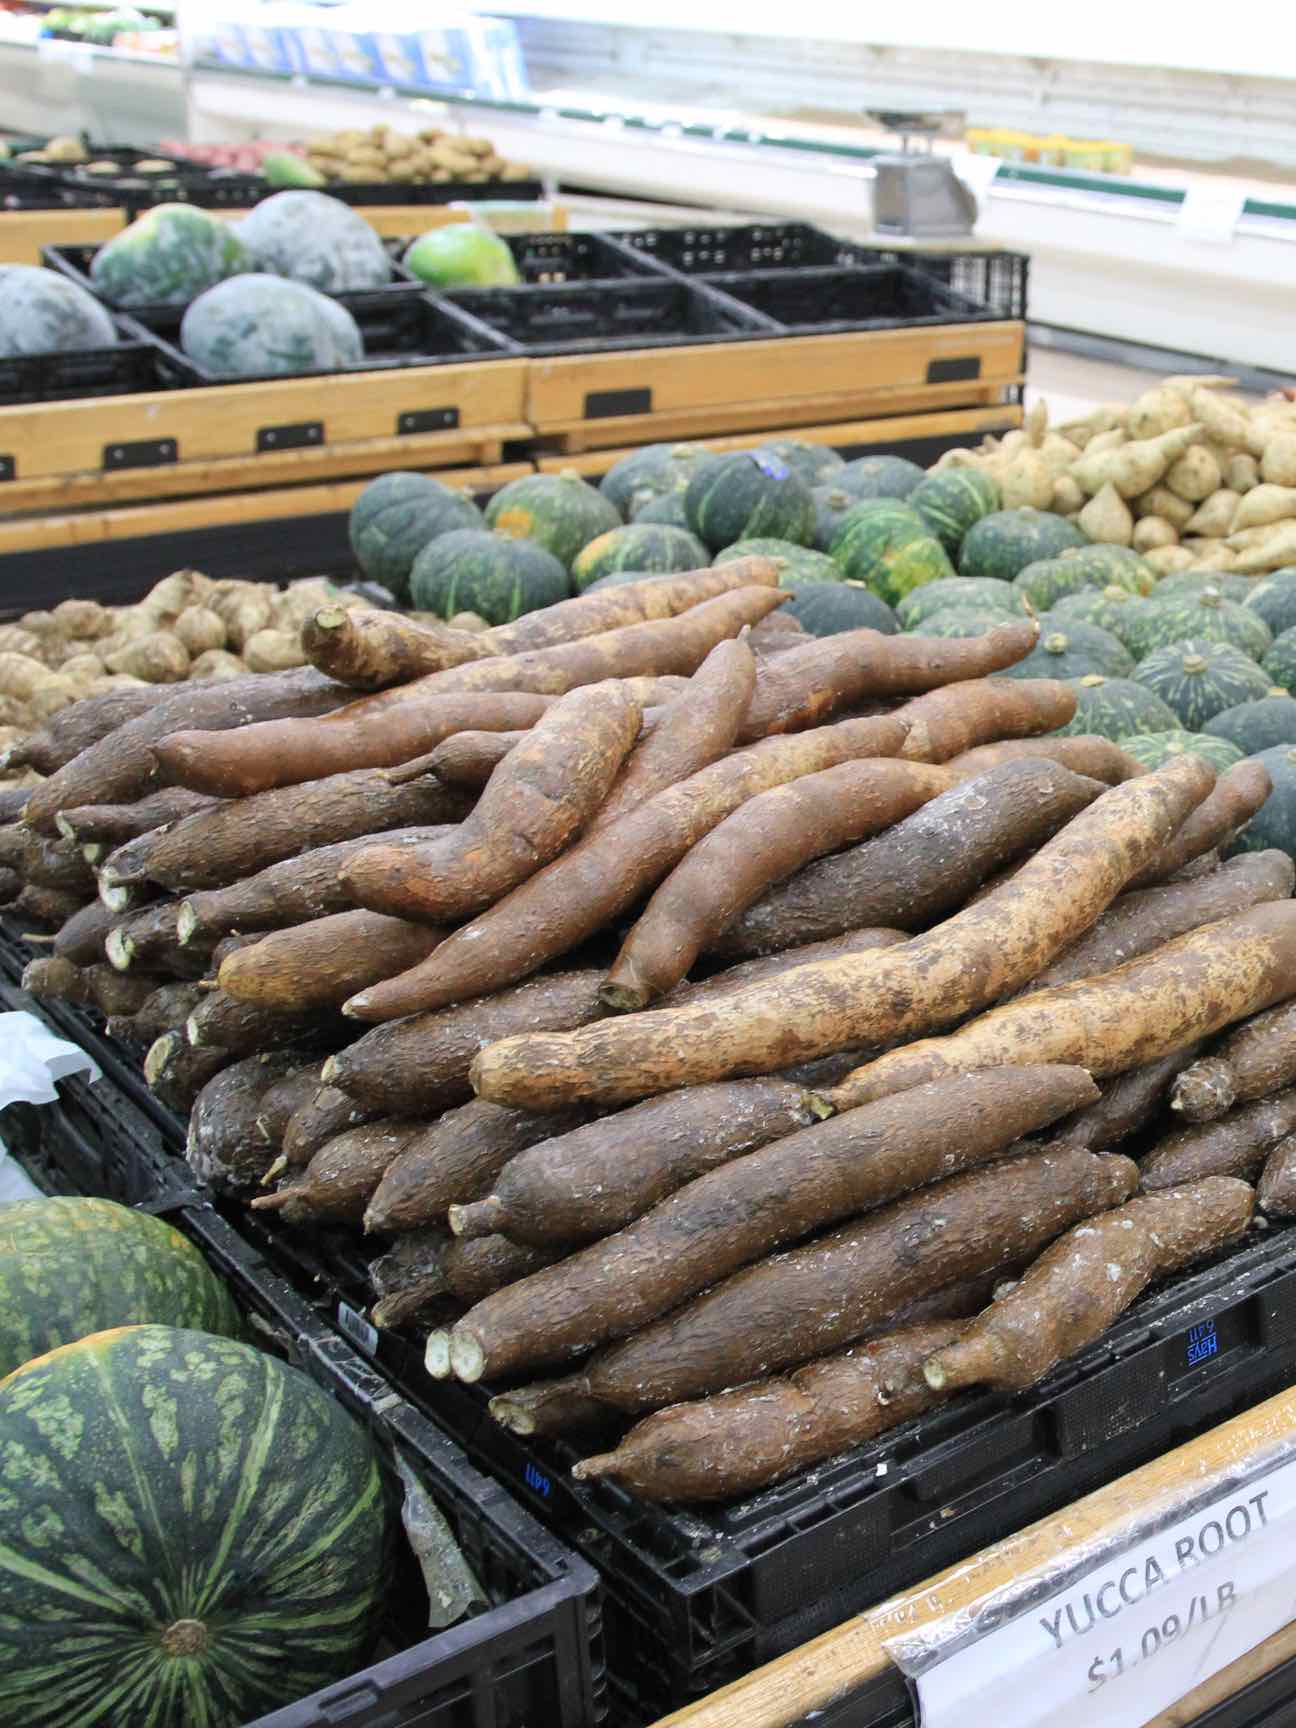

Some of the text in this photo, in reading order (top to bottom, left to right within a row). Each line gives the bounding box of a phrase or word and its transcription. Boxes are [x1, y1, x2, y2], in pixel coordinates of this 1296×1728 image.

[1039, 1490, 1270, 1649] YUCCA ROOT
[1086, 1580, 1238, 1694] $1.09/LB
